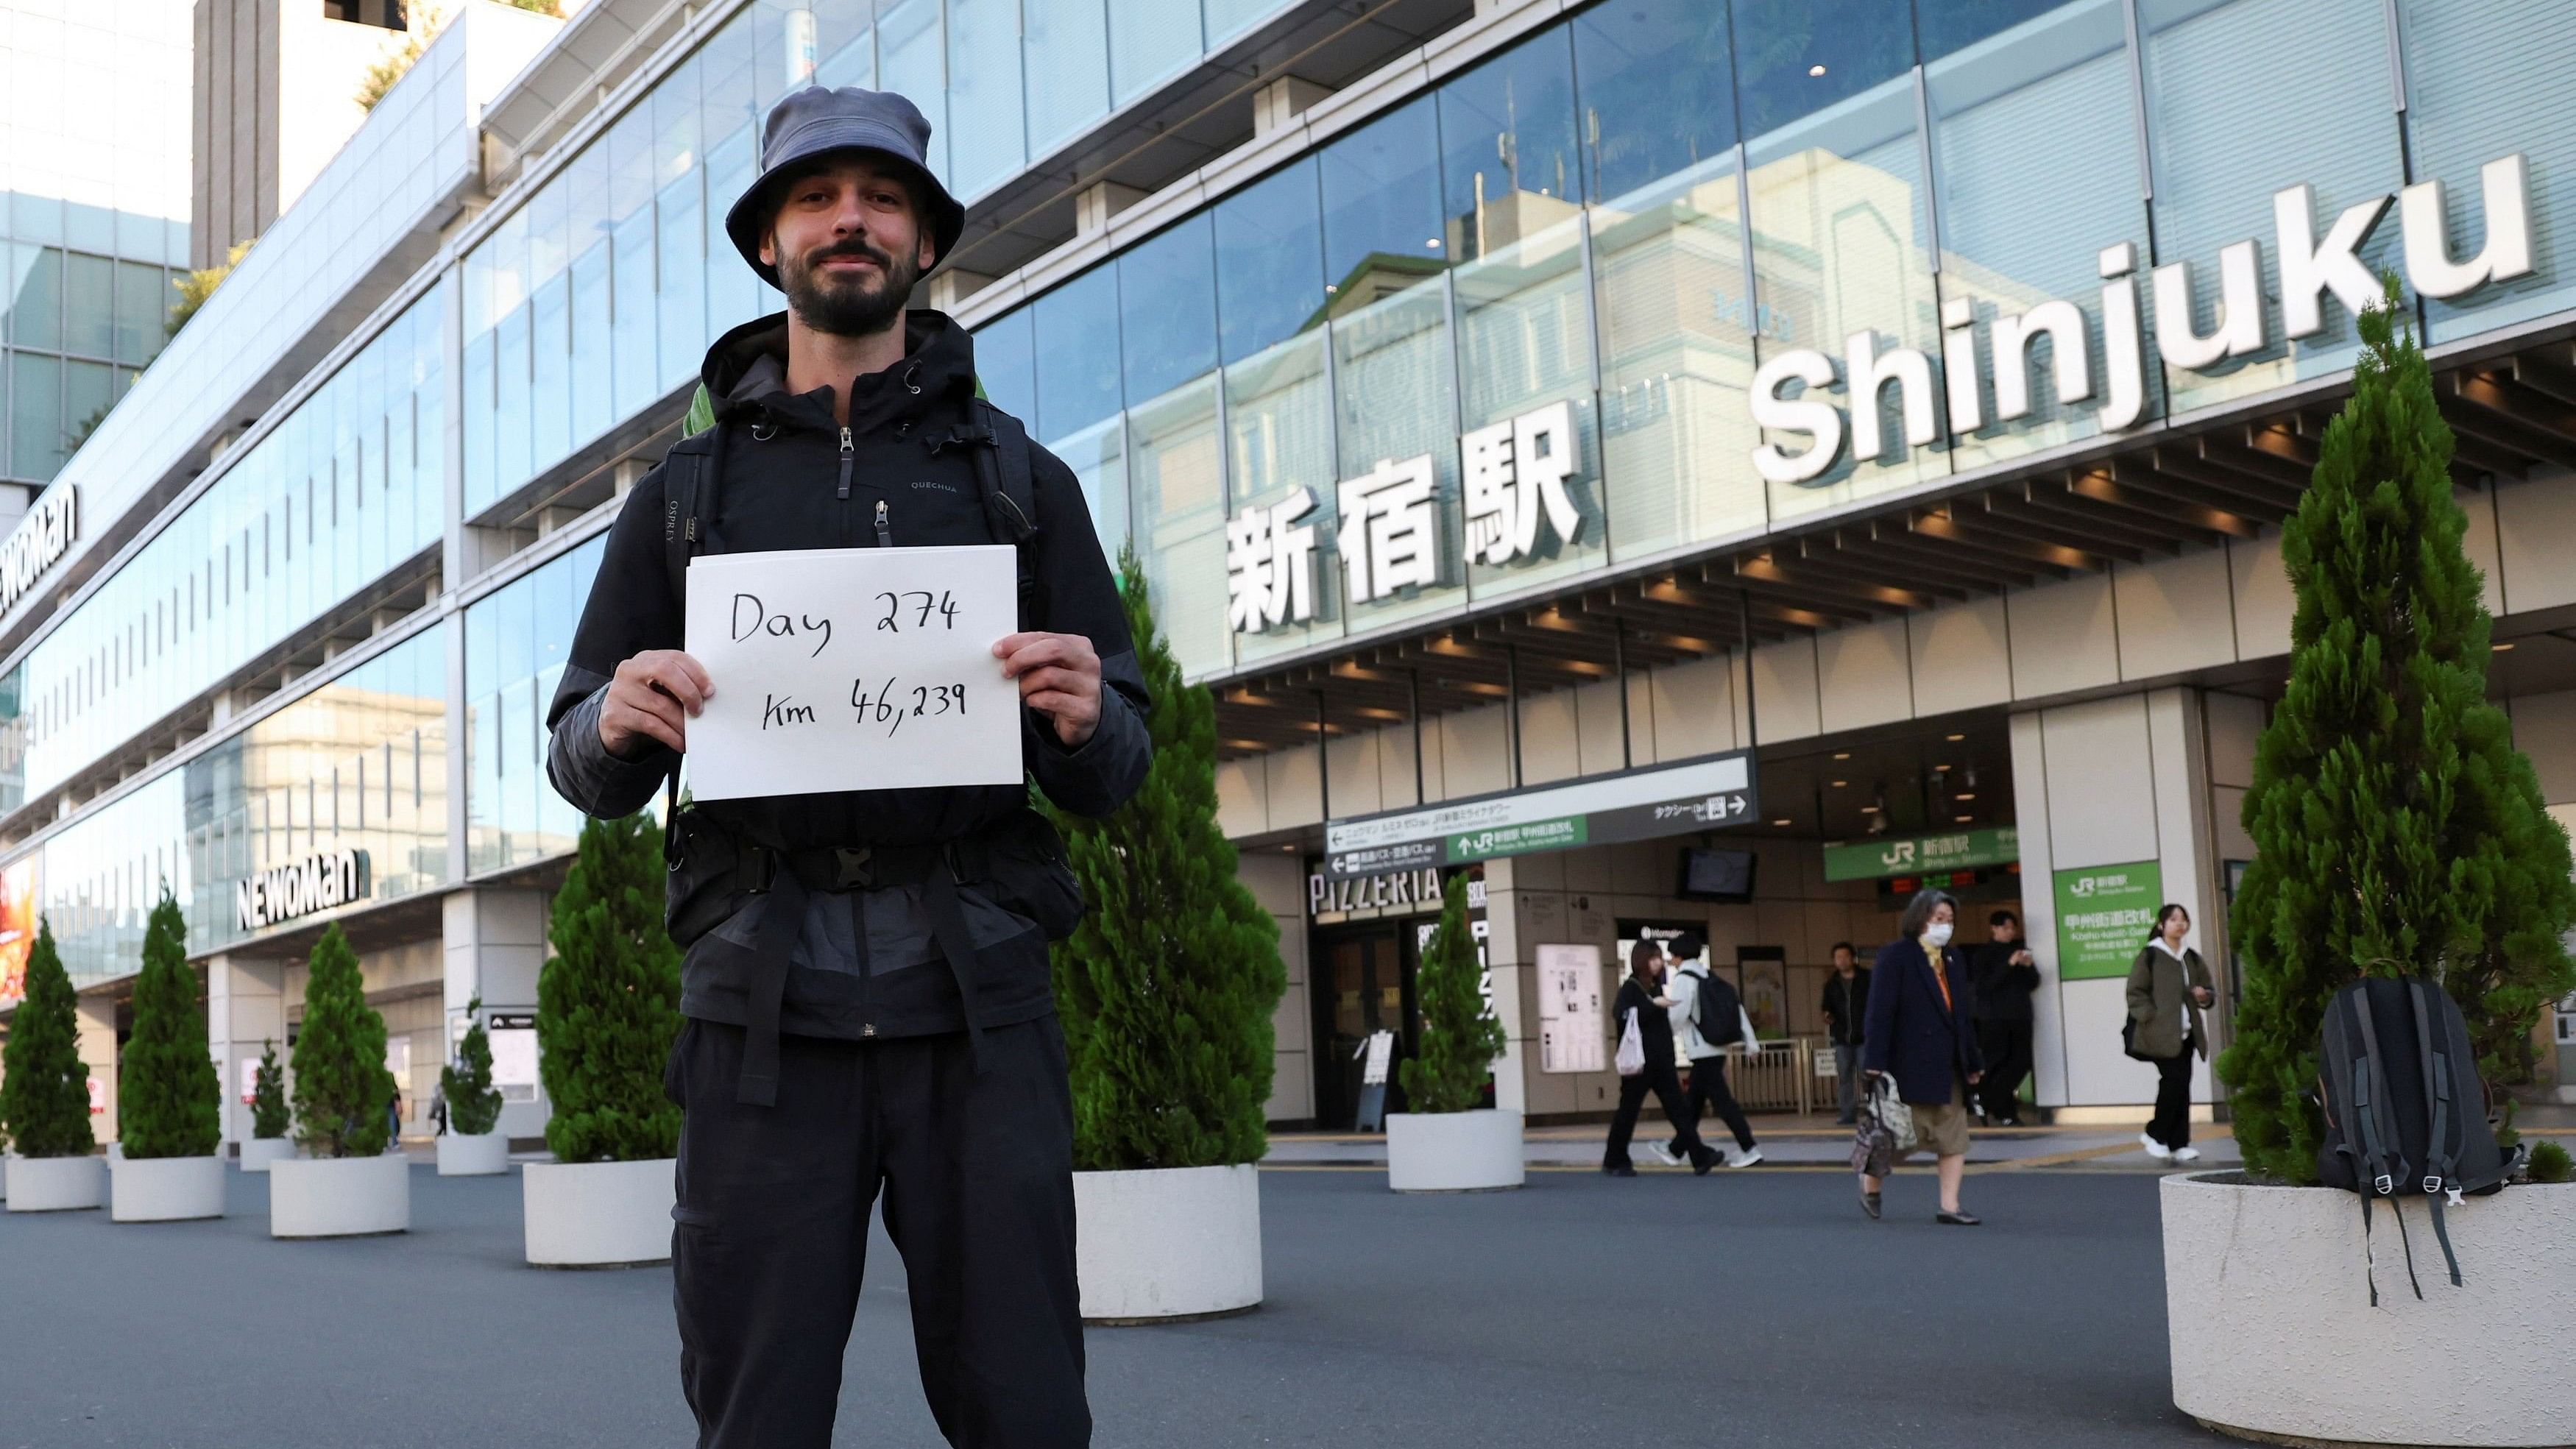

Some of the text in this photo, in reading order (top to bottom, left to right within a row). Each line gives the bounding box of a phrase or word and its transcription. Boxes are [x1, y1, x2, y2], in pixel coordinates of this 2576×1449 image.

[1750, 152, 2539, 484] Shinjuku
[911, 481, 957, 493] QUECHUA
[665, 500, 678, 543] OSPREY
[1226, 400, 1582, 633] 新宿駅
[732, 590, 961, 658] Day 274
[852, 676, 966, 738] 46,239
[1473, 832, 1493, 849] JR
[1882, 842, 1915, 865] JR
[1309, 868, 1443, 915] PIZZERIA
[2070, 877, 2095, 893] JR
